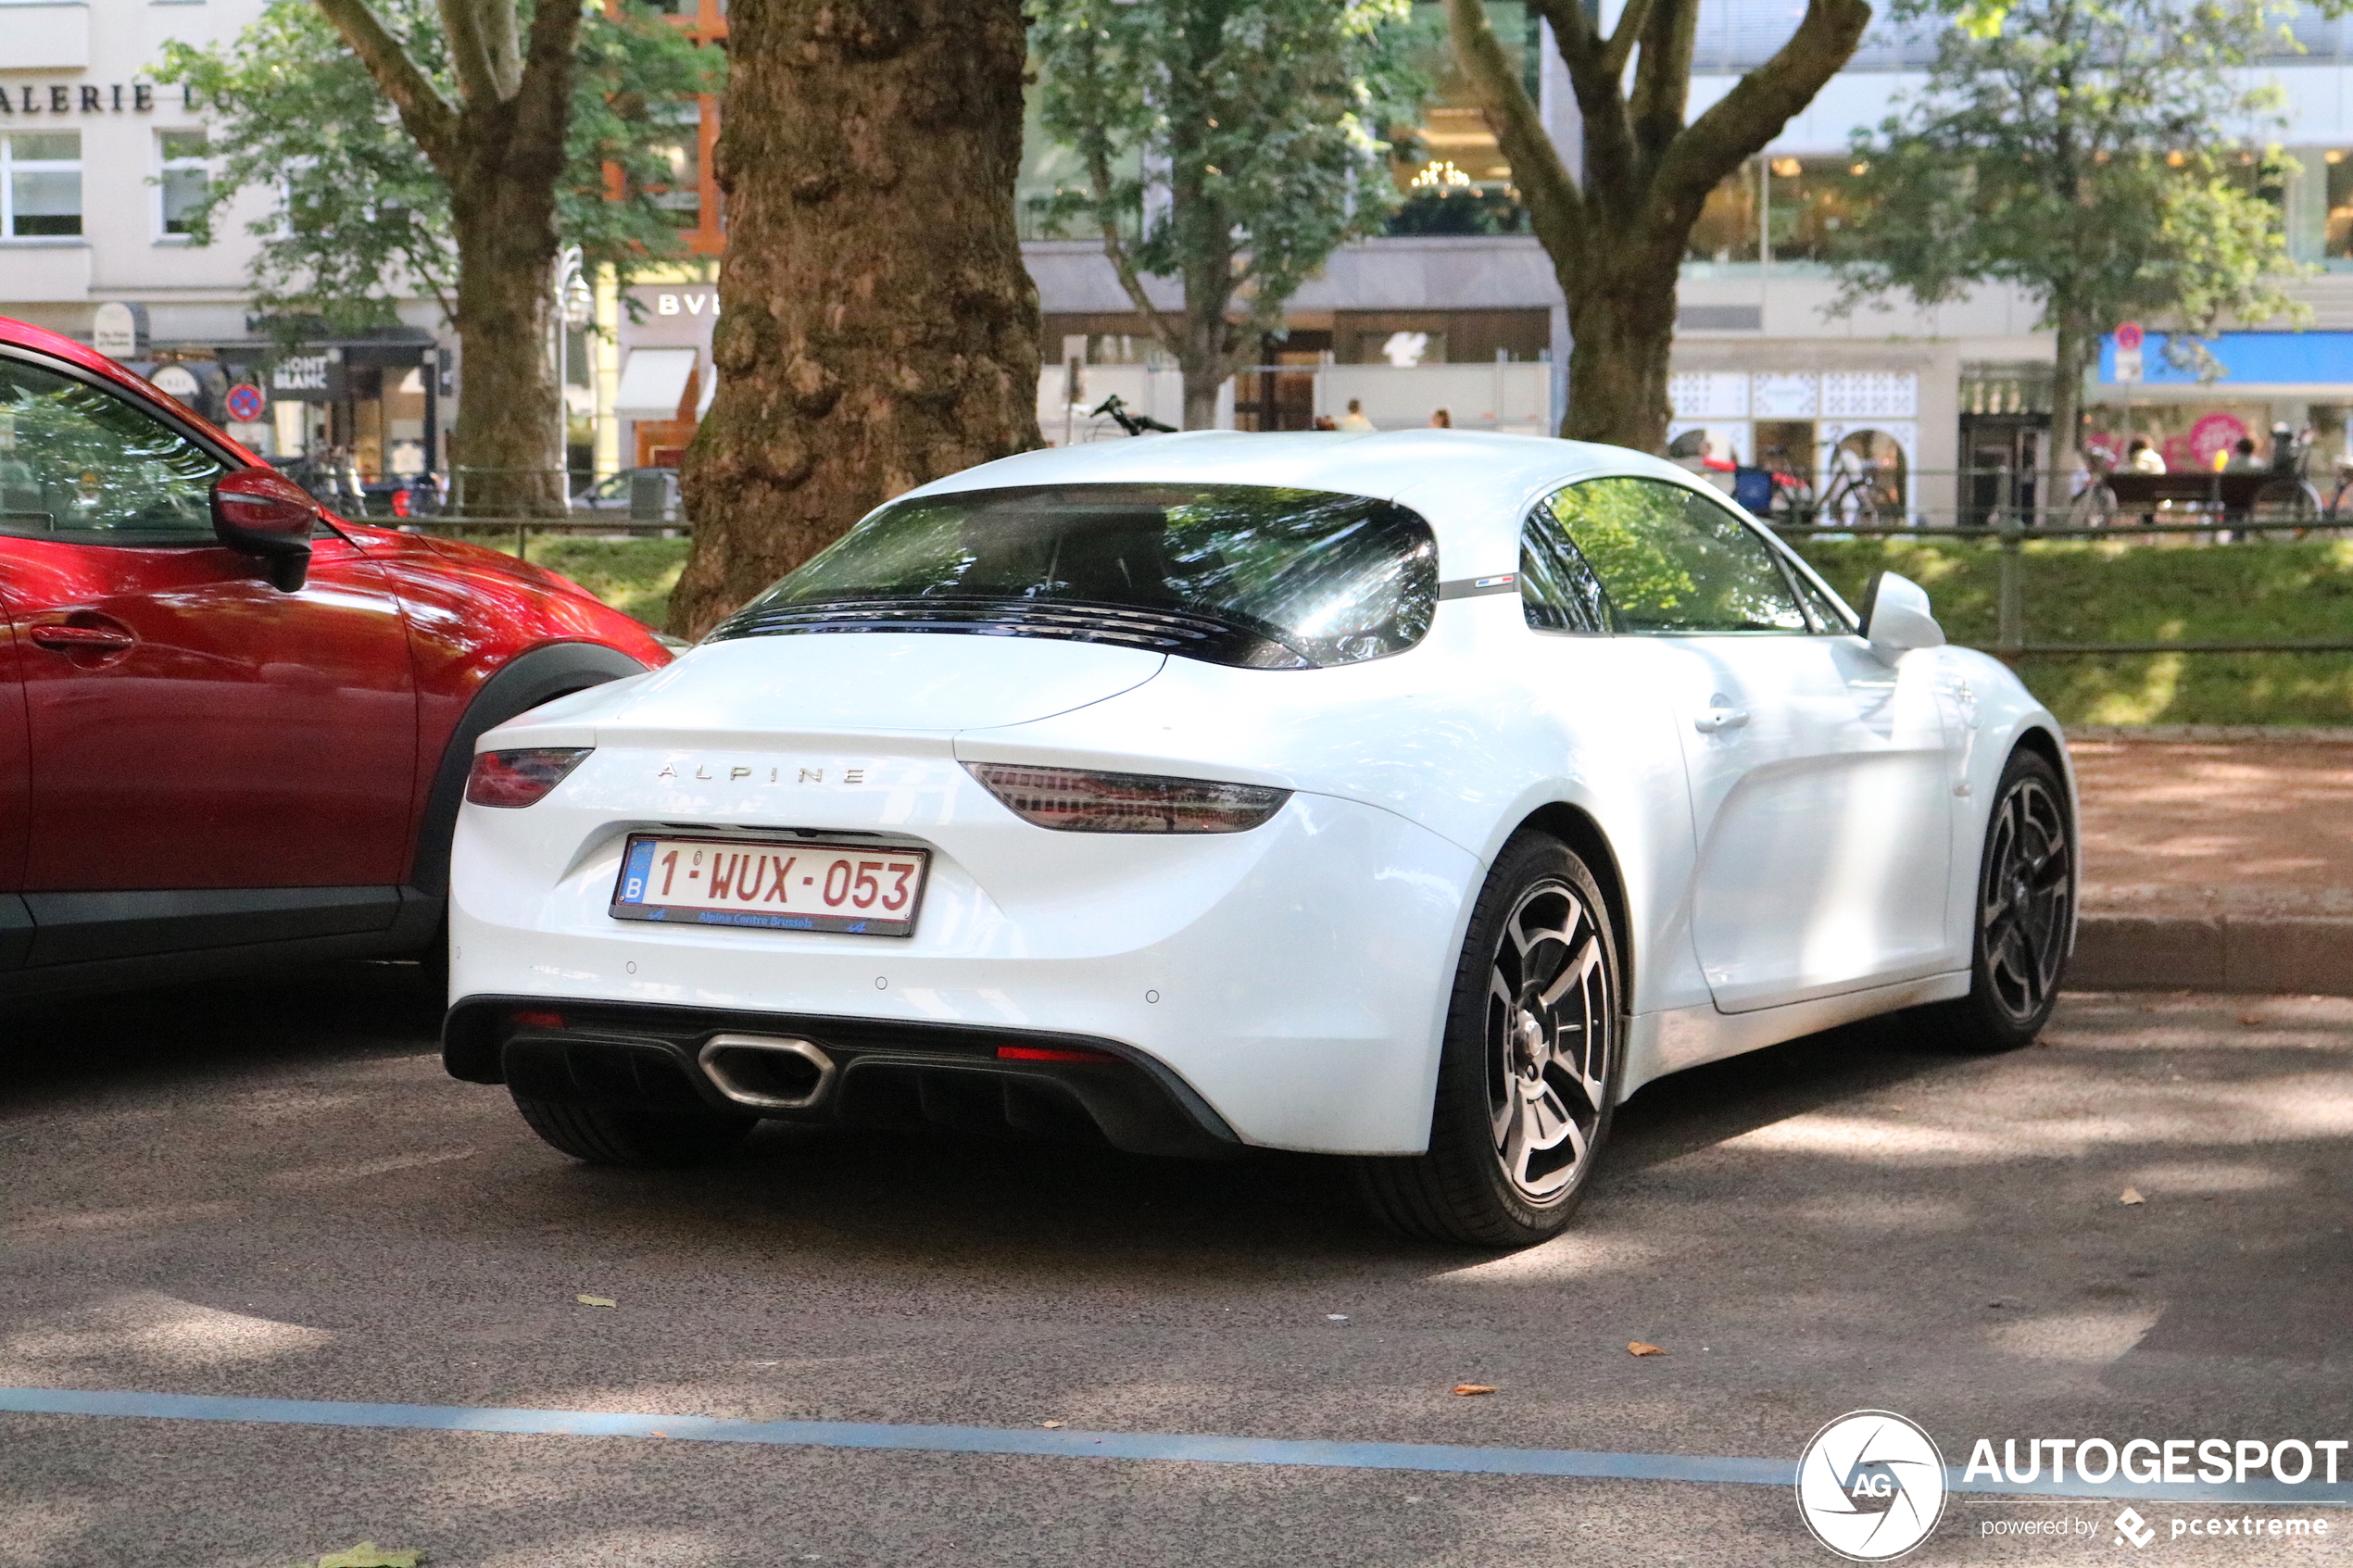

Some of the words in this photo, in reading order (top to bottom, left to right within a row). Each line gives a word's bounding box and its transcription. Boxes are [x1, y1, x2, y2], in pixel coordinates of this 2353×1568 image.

[273, 372, 328, 389] BLANC
[658, 762, 863, 783] ALPINE
[625, 878, 642, 898] B
[661, 850, 914, 910] 1-WUX-053
[698, 911, 731, 923] Alpine
[734, 914, 768, 925] Centre
[771, 916, 813, 928] Brussels
